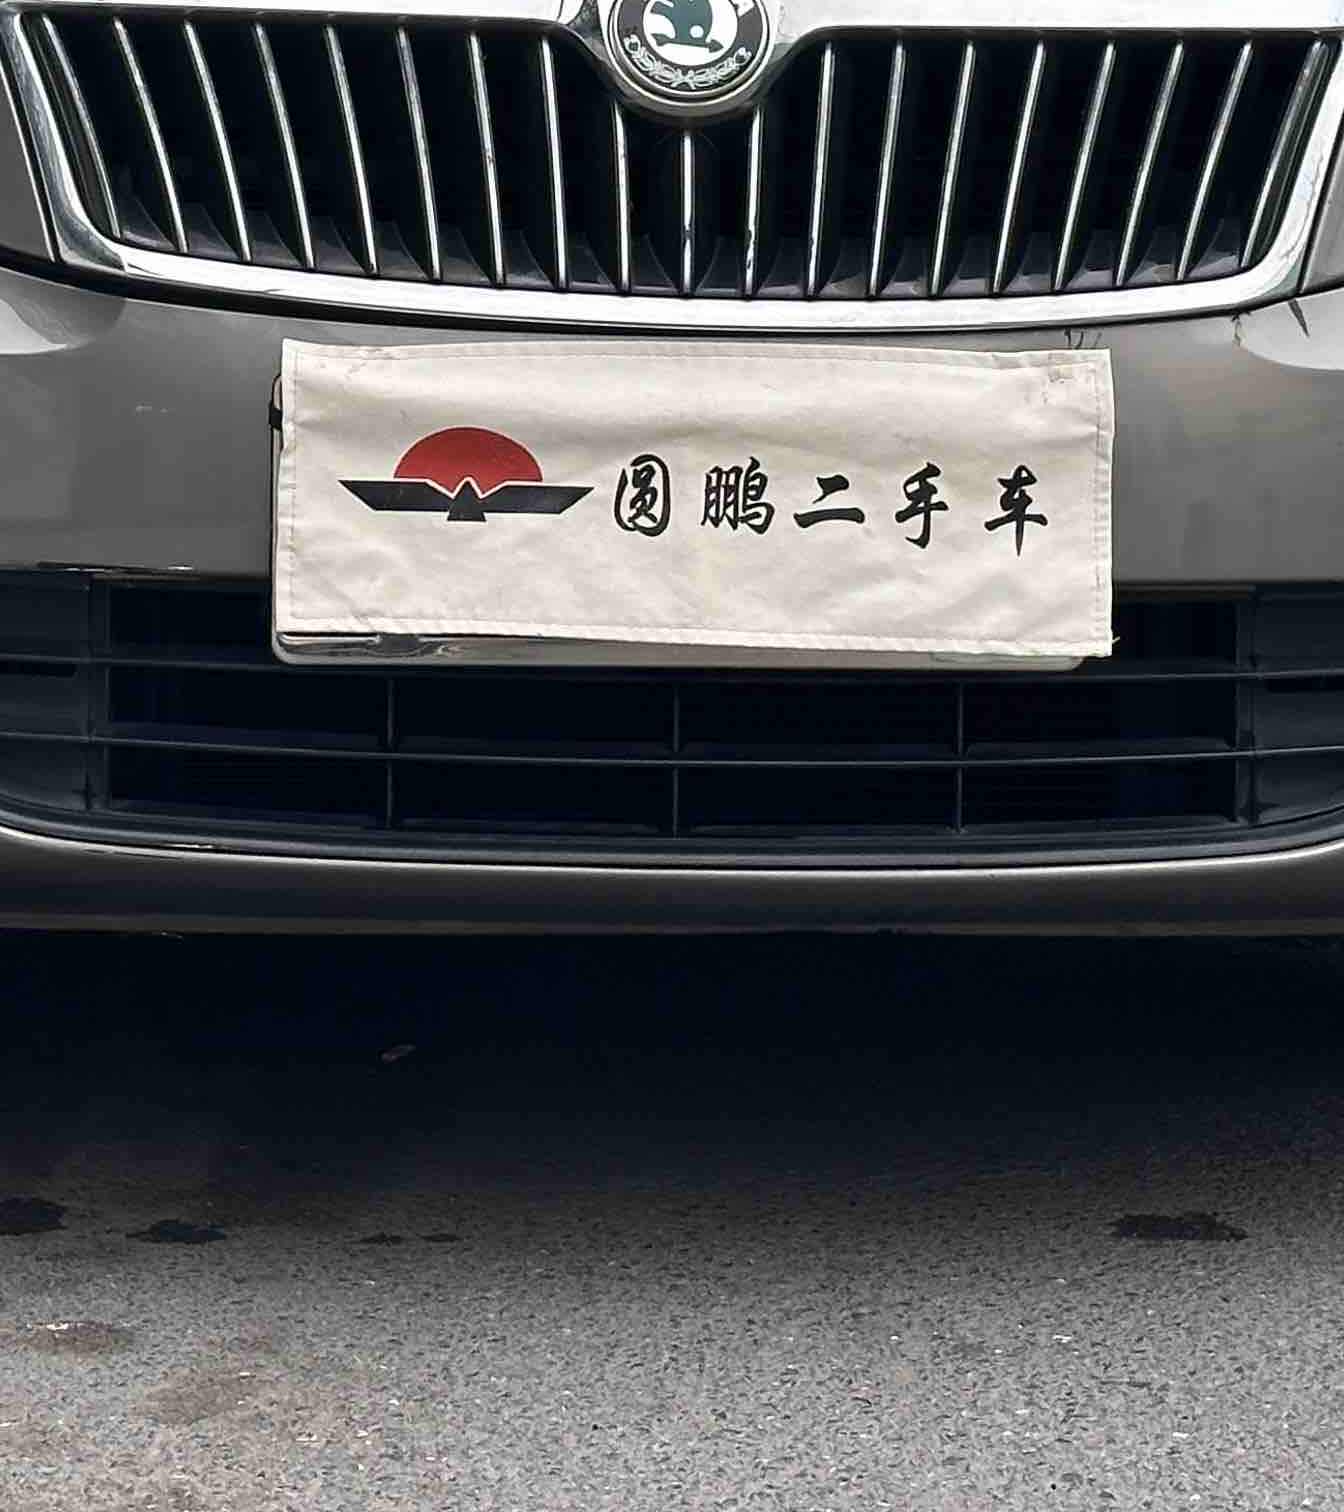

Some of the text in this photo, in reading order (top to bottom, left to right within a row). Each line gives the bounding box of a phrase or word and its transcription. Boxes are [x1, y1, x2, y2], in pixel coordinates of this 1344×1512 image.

[613, 453, 1049, 557] 圆鹏二手车
